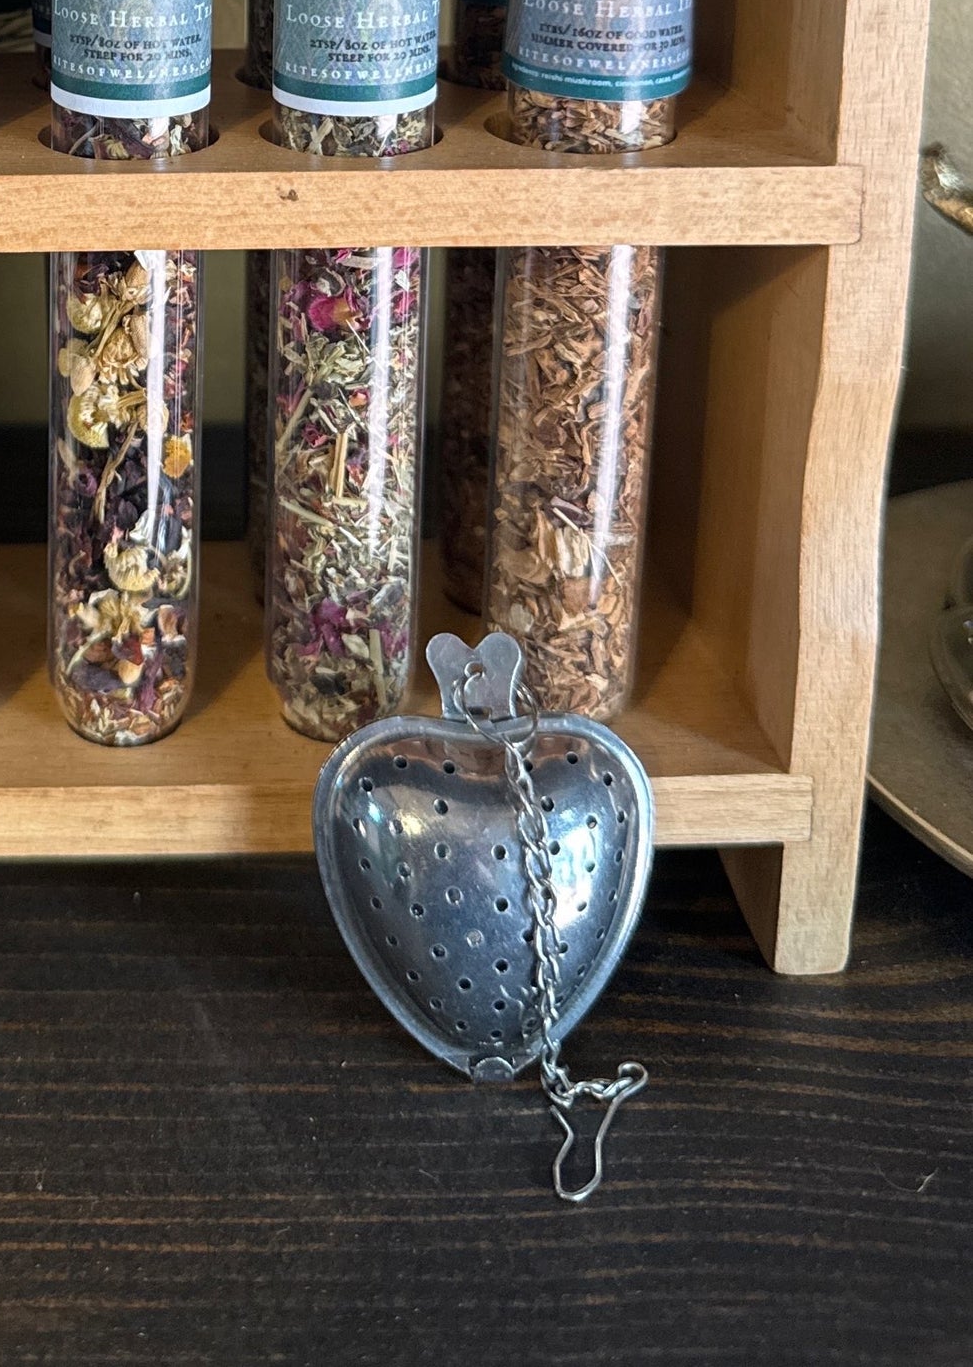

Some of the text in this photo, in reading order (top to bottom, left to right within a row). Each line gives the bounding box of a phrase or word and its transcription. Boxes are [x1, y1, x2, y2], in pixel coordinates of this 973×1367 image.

[594, 0, 673, 20] HERBAL
[109, 10, 189, 29] HERBAL
[286, 4, 428, 30] LOOSE HERBAL
[605, 29, 622, 40] OF
[124, 40, 140, 50] OF
[371, 40, 386, 50] OF
[390, 38, 413, 49] HOT
[576, 40, 633, 53] COVERED
[635, 41, 658, 51] OR
[83, 48, 118, 61] STEEP
[120, 52, 145, 62] FOR
[147, 52, 162, 61] 20
[328, 52, 365, 63] STEEP
[367, 53, 391, 63] FOR
[393, 51, 407, 61] 20
